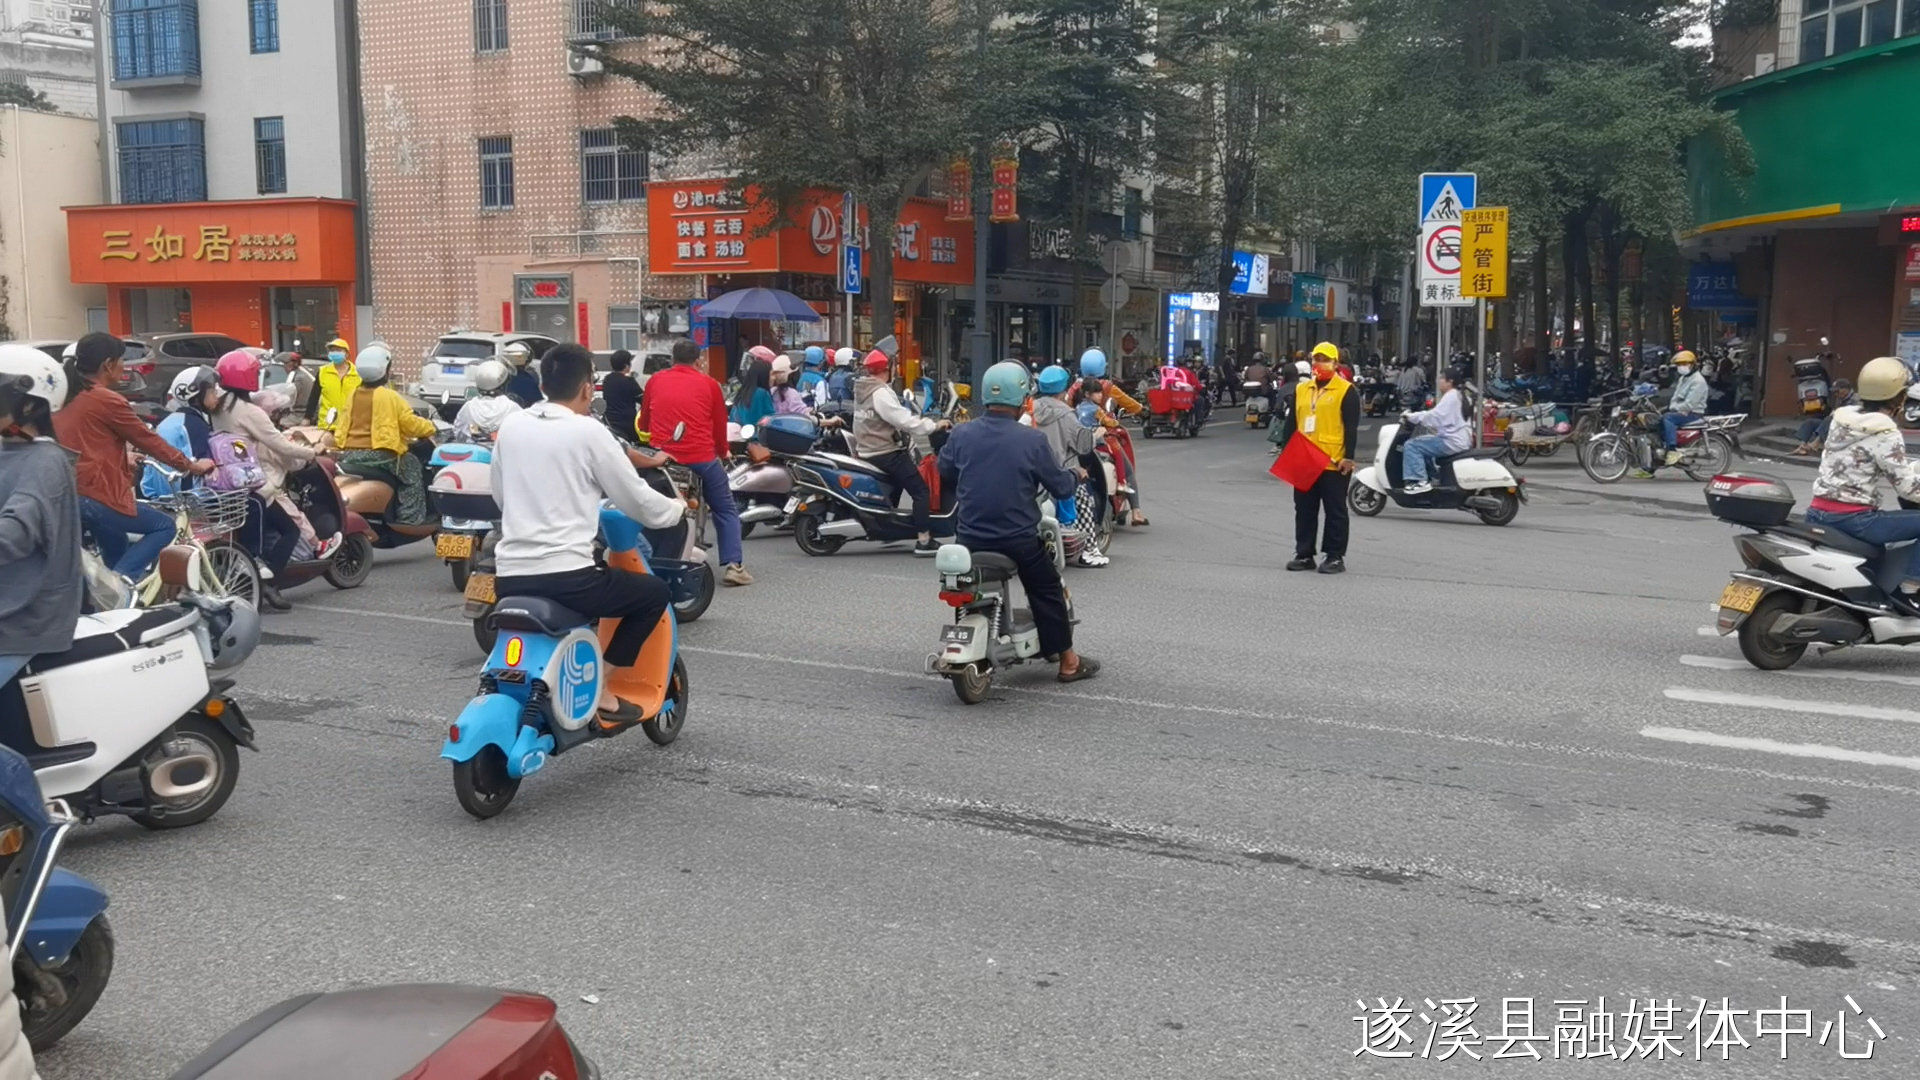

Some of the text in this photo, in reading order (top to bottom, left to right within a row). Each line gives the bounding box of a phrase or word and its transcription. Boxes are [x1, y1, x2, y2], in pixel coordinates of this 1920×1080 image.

[1463, 211, 1504, 223] 交通秩序管理
[677, 219, 742, 236] 快餐 云吞
[100, 225, 234, 262] 三如居
[677, 240, 745, 258] 面食 汤粉
[1472, 223, 1494, 293] 严管街
[1425, 283, 1466, 301] 黄标
